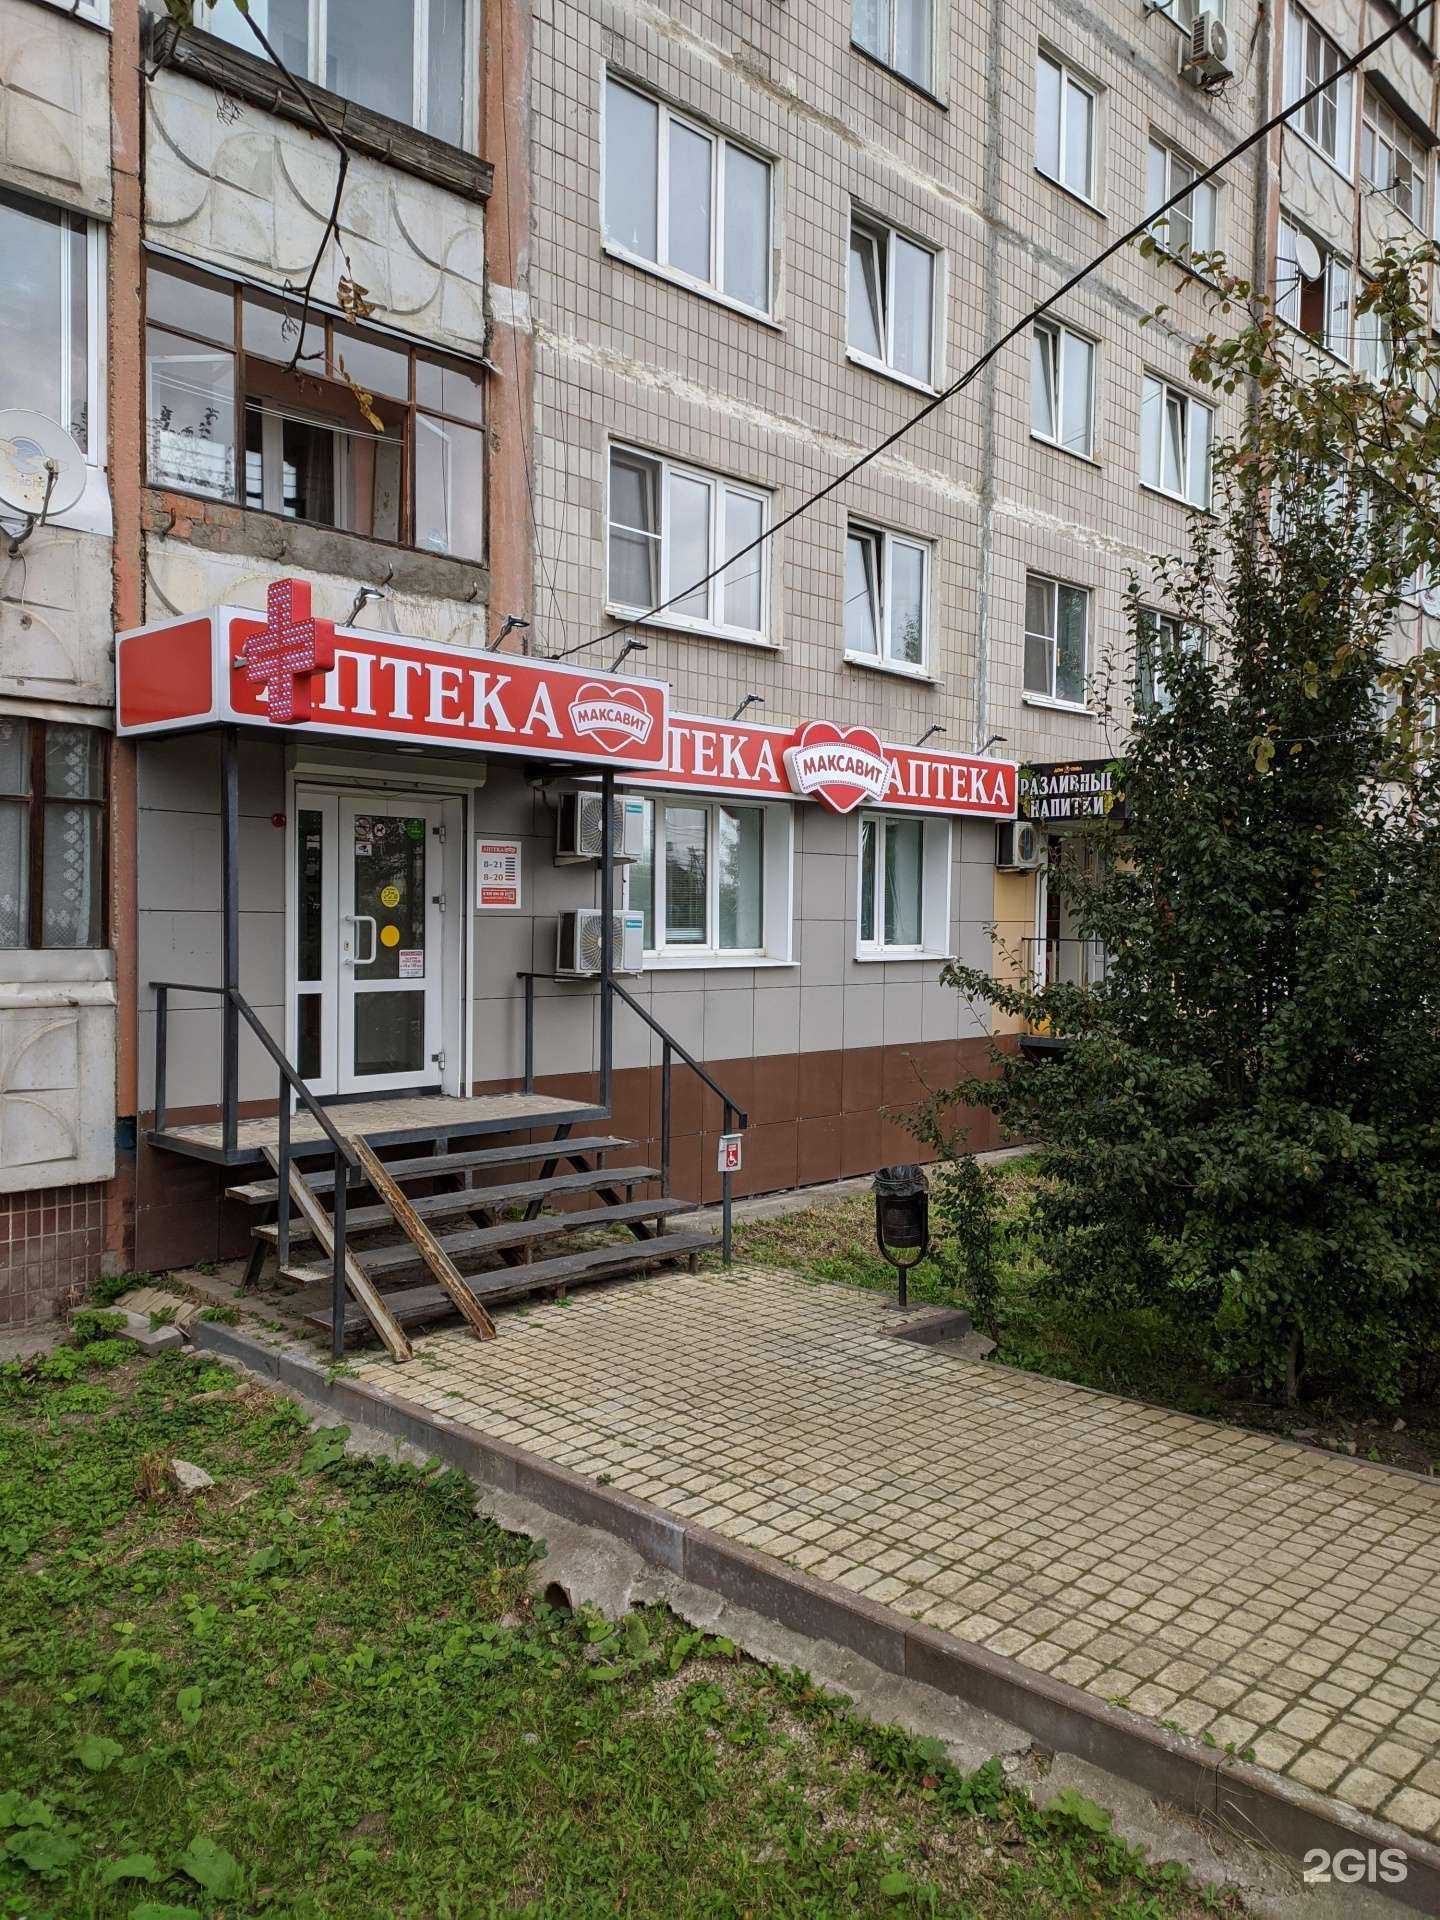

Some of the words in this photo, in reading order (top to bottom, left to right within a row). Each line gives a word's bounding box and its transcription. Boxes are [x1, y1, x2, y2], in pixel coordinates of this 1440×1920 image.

[255, 648, 564, 739] ПТЕКА
[577, 708, 647, 732] МАКСАВИТ
[668, 726, 781, 783] ТЕКА
[803, 754, 883, 785] МАКСАВИТ
[885, 756, 1010, 806] АПТЕКА
